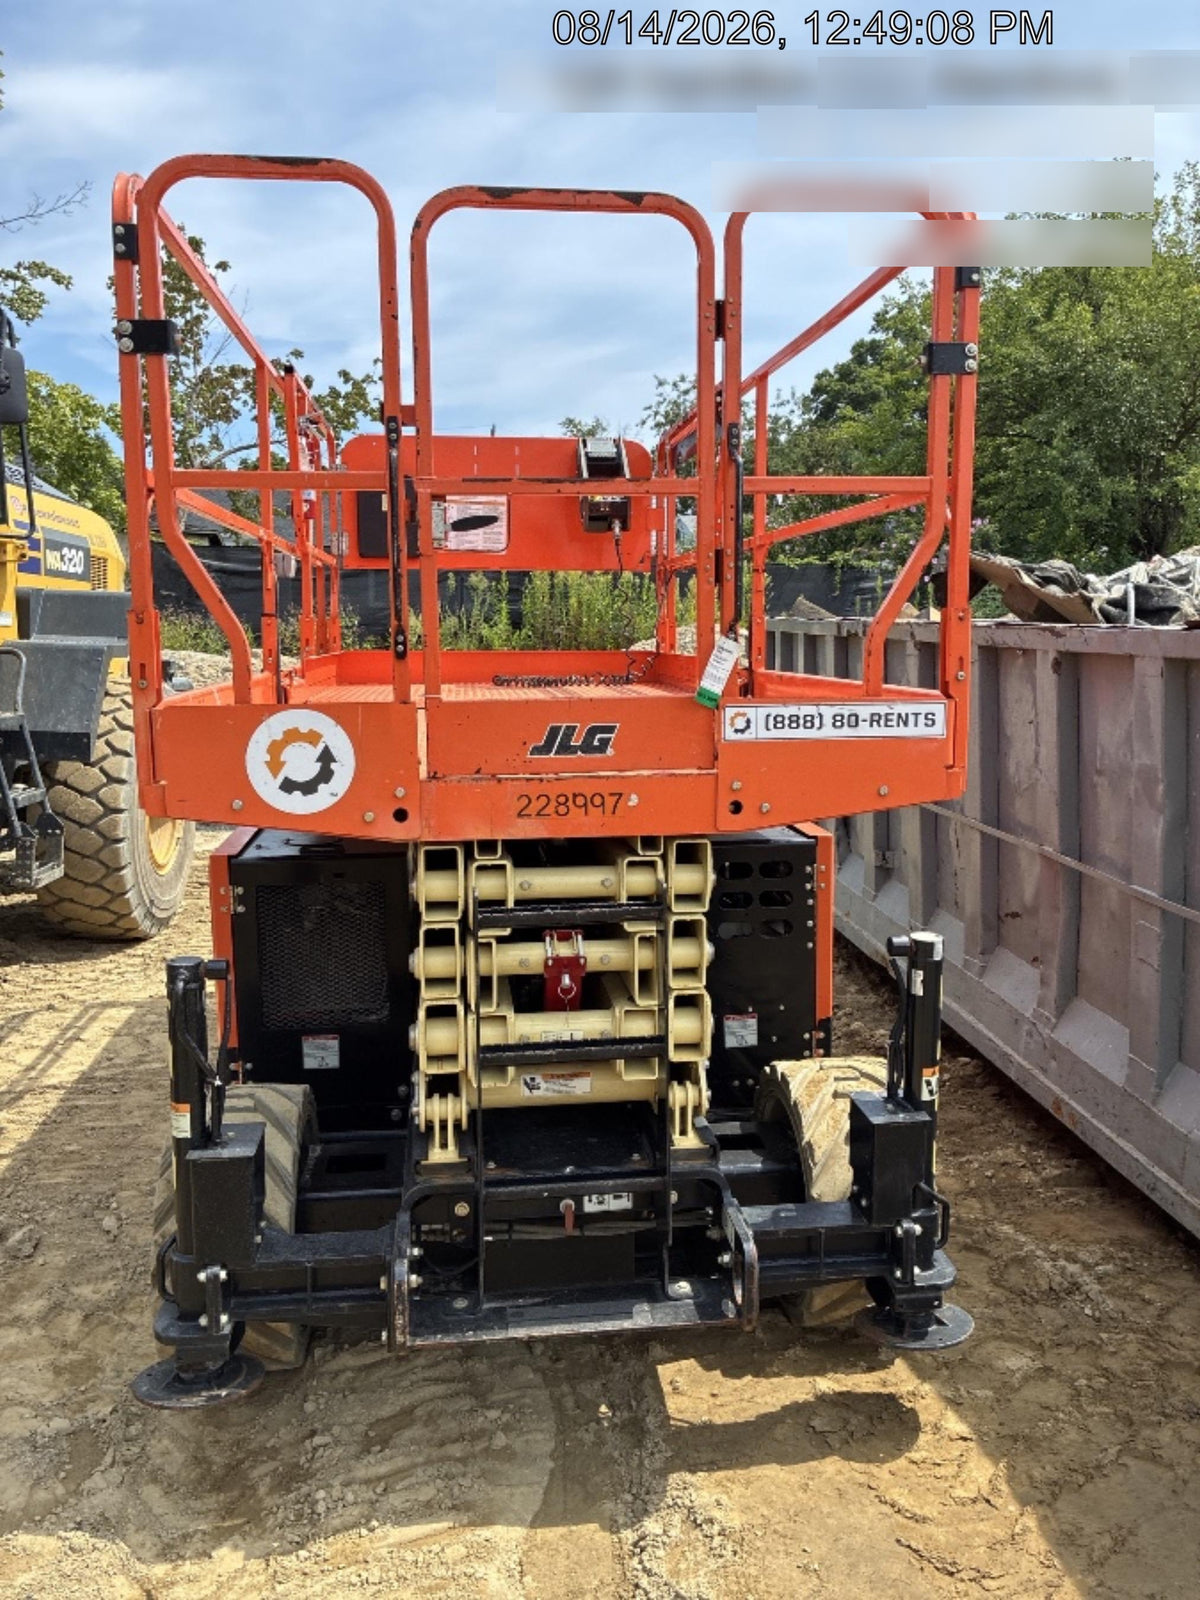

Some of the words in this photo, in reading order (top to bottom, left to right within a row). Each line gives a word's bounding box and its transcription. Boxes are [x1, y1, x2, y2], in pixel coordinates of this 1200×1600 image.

[764, 713, 825, 732] (888)
[831, 711, 937, 731] 80-RENTS
[527, 722, 620, 758] JLG
[516, 792, 624, 818] 228997
